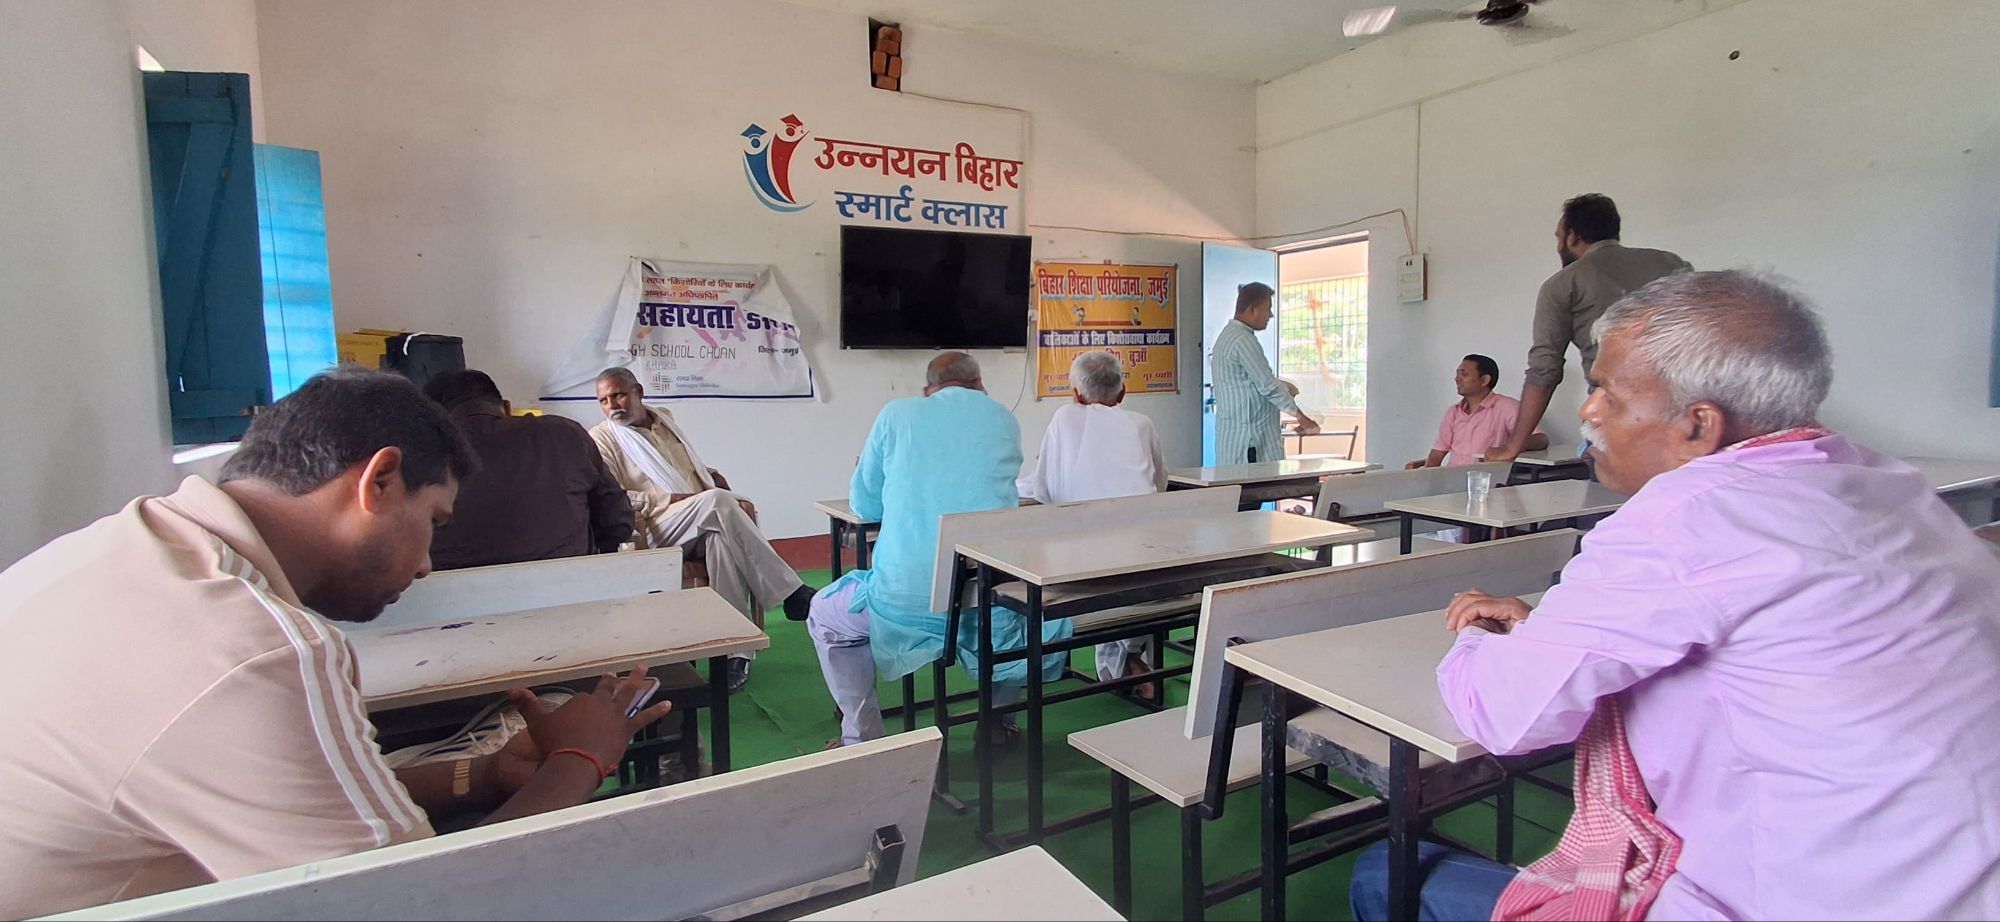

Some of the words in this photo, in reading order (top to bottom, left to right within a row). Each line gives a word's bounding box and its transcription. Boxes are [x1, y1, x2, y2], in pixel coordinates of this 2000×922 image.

[814, 137, 951, 181] उन्नयन
[955, 142, 1023, 191] बिहार
[834, 185, 914, 223] स्मार्ट
[922, 199, 1008, 229] क्लास
[1039, 268, 1064, 295] बिहार
[1068, 269, 1093, 295] शिक्षा
[1147, 272, 1169, 303] जमुई
[637, 302, 735, 329] सहायता
[651, 344, 695, 358] SCHOOL
[699, 345, 736, 360] CHUAN
[1081, 331, 1089, 345] के
[1091, 331, 1106, 345] लिए
